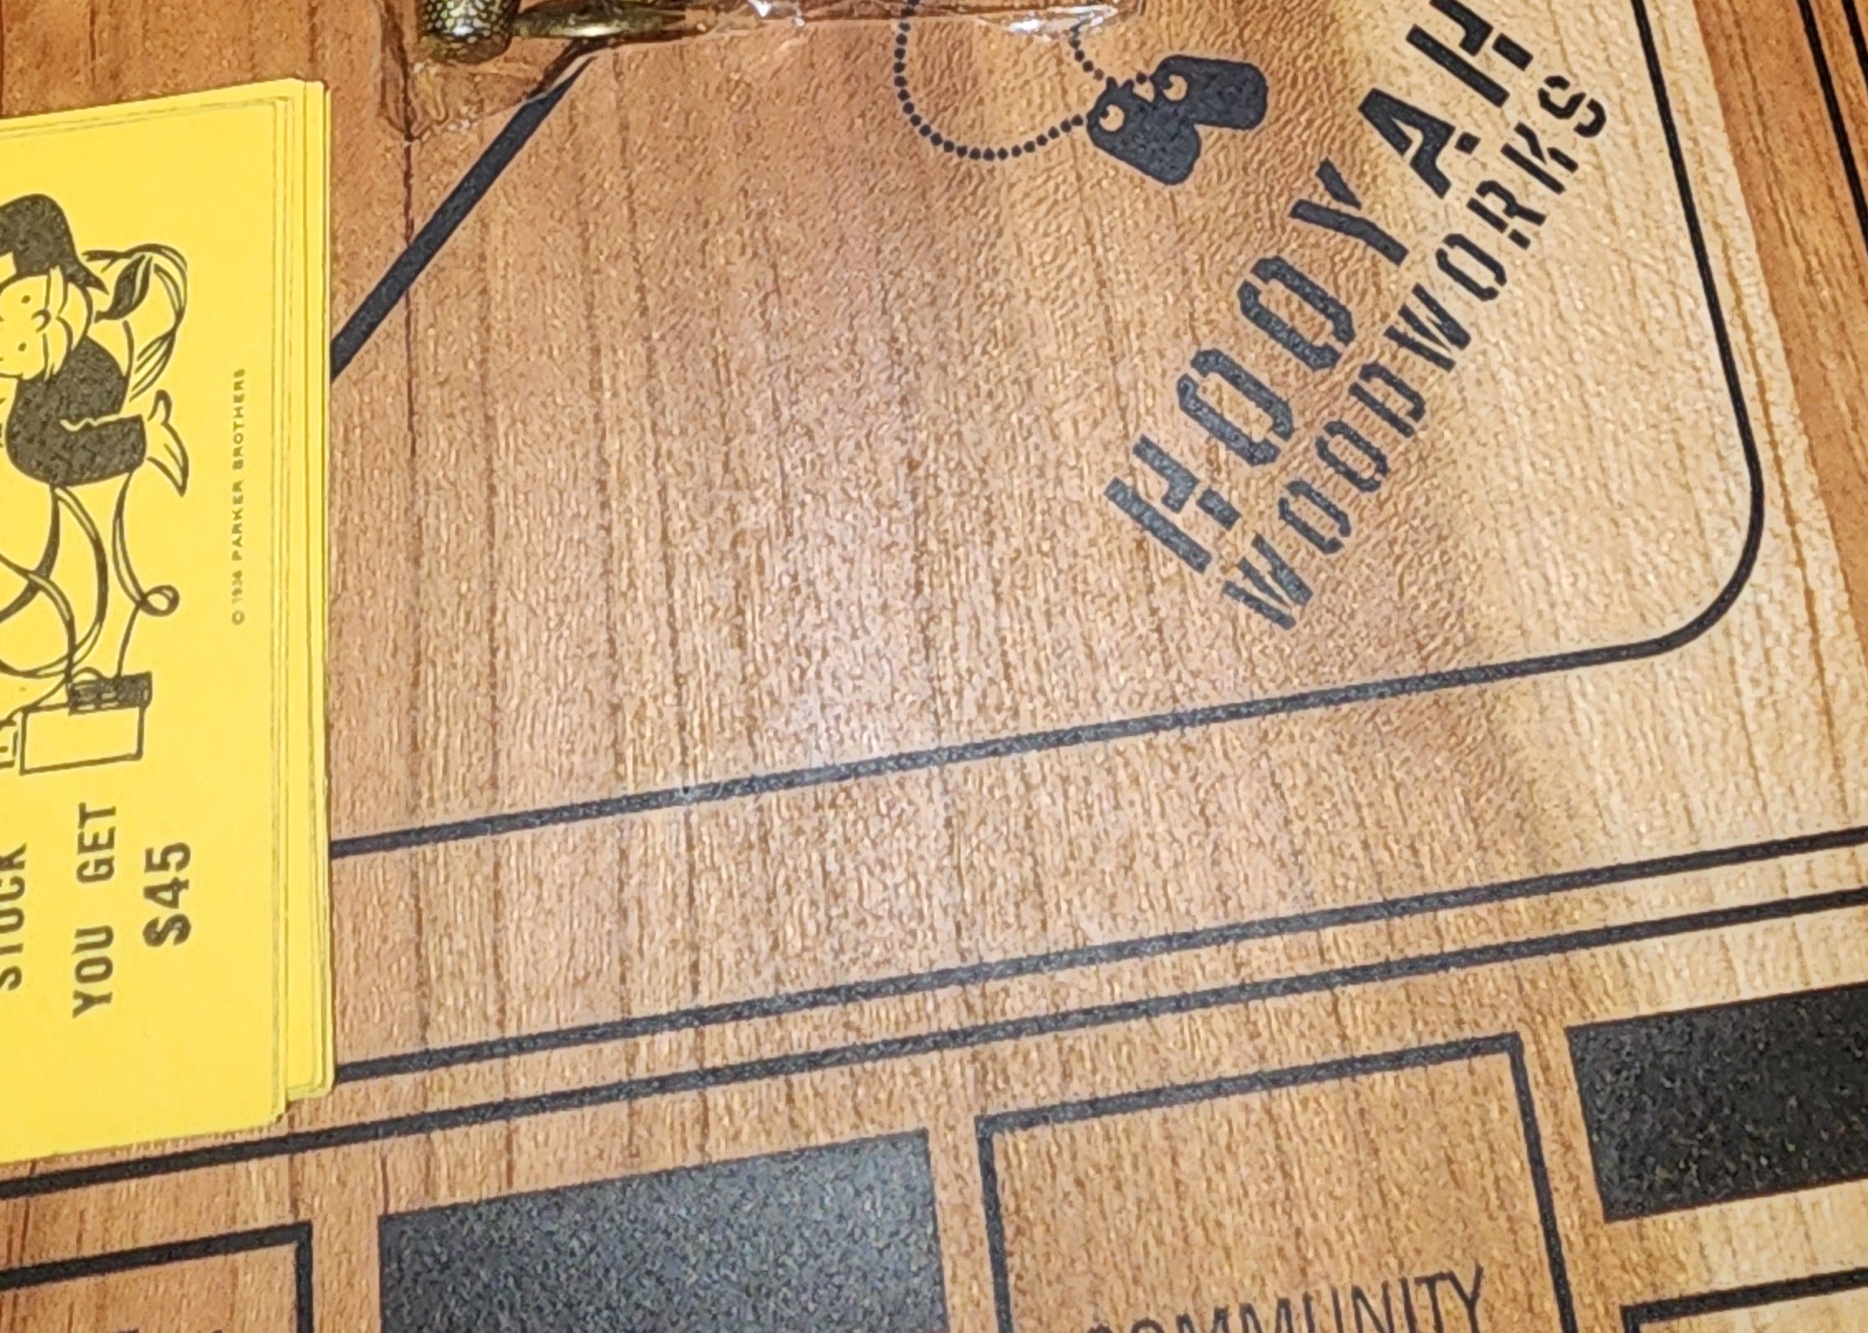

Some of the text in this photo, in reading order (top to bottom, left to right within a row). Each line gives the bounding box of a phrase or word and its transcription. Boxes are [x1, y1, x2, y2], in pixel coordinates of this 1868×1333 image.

[1222, 74, 1607, 631] WOODWORKS
[232, 367, 247, 471] BROTHERS
[231, 479, 246, 562] PARKER
[72, 801, 117, 1019] YOU GET
[142, 841, 192, 949] $45
